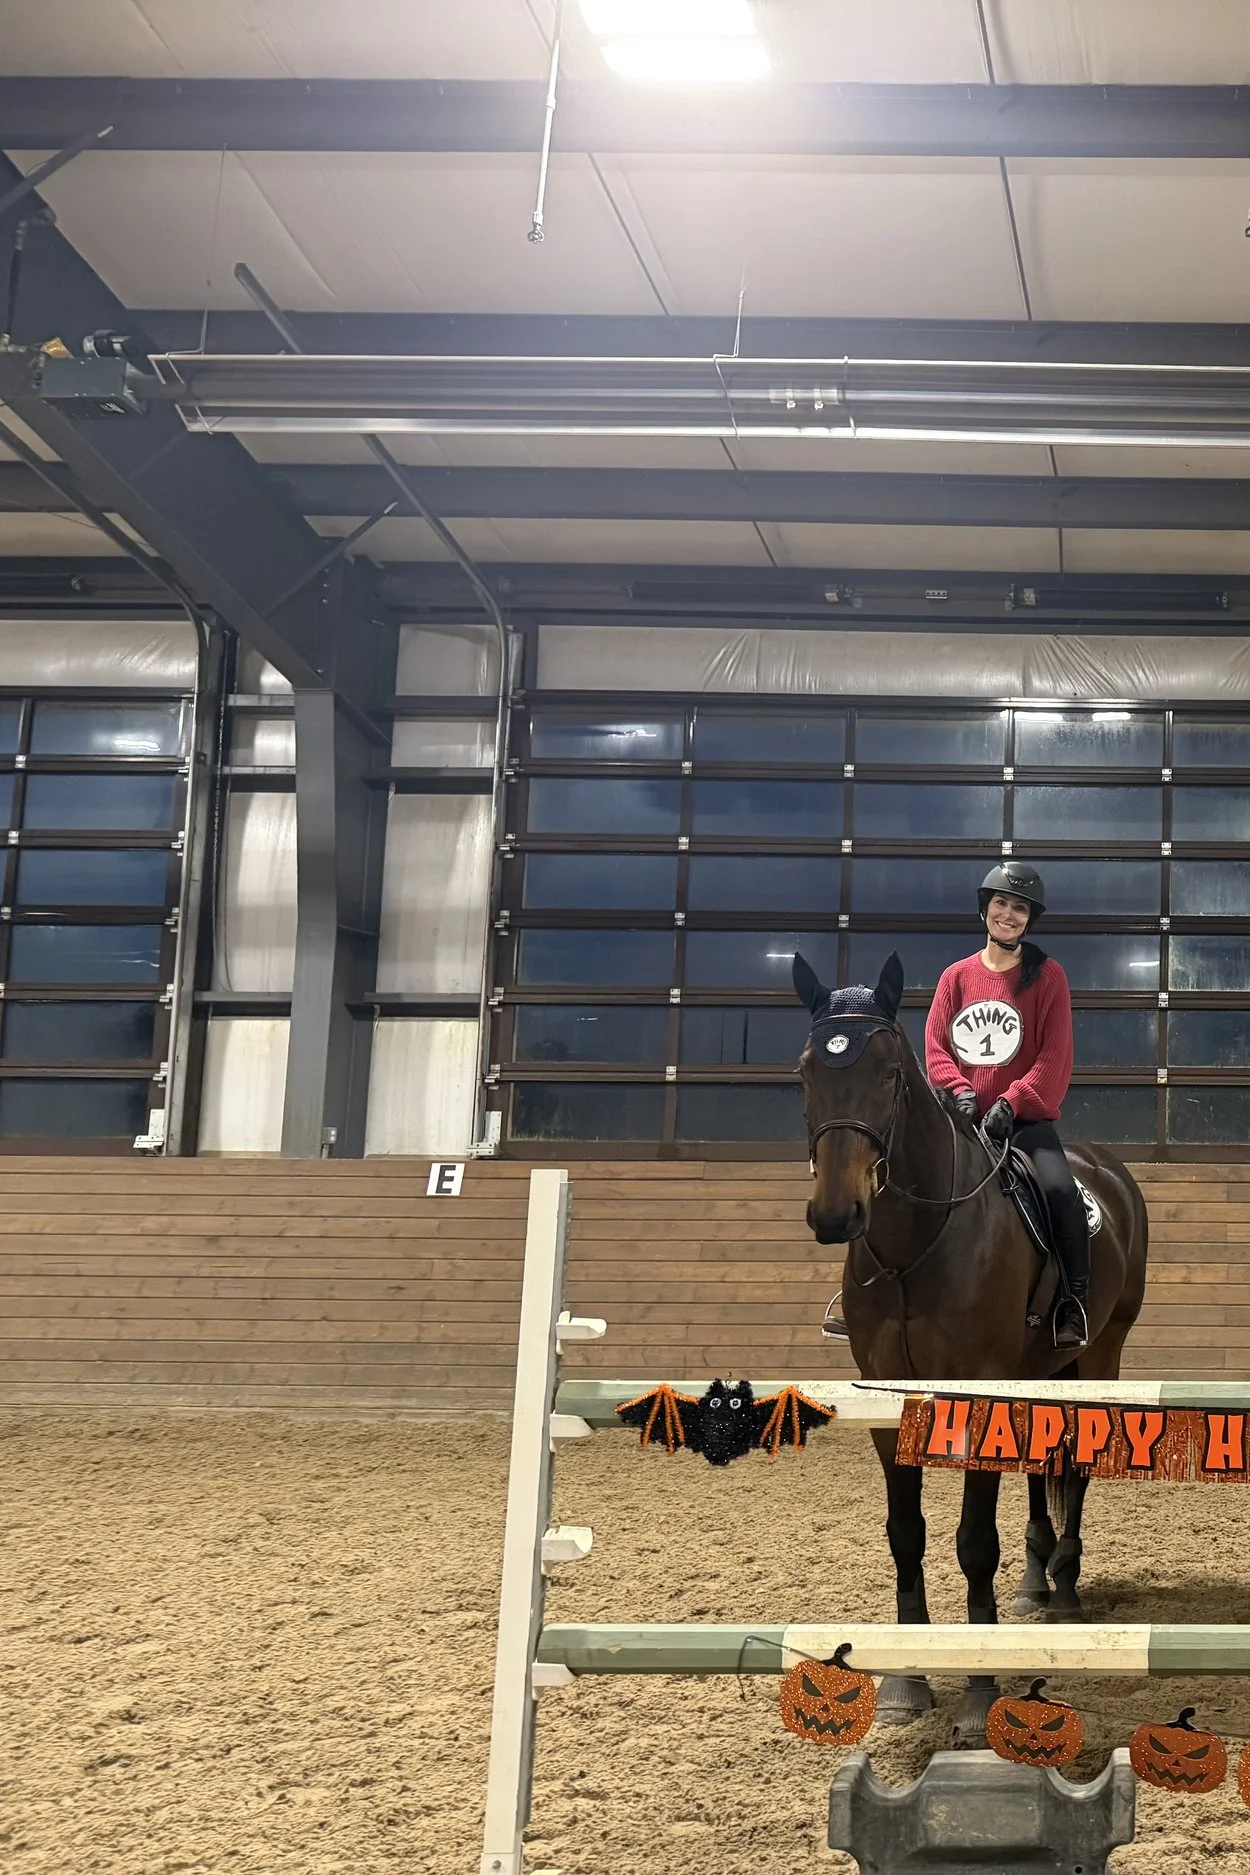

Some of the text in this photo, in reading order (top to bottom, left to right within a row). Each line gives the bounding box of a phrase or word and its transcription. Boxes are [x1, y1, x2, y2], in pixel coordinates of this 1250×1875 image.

[956, 1007, 1018, 1035] THING
[979, 1033, 996, 1056] 1
[435, 1164, 457, 1194] E
[924, 1399, 1166, 1470] HAPPY
